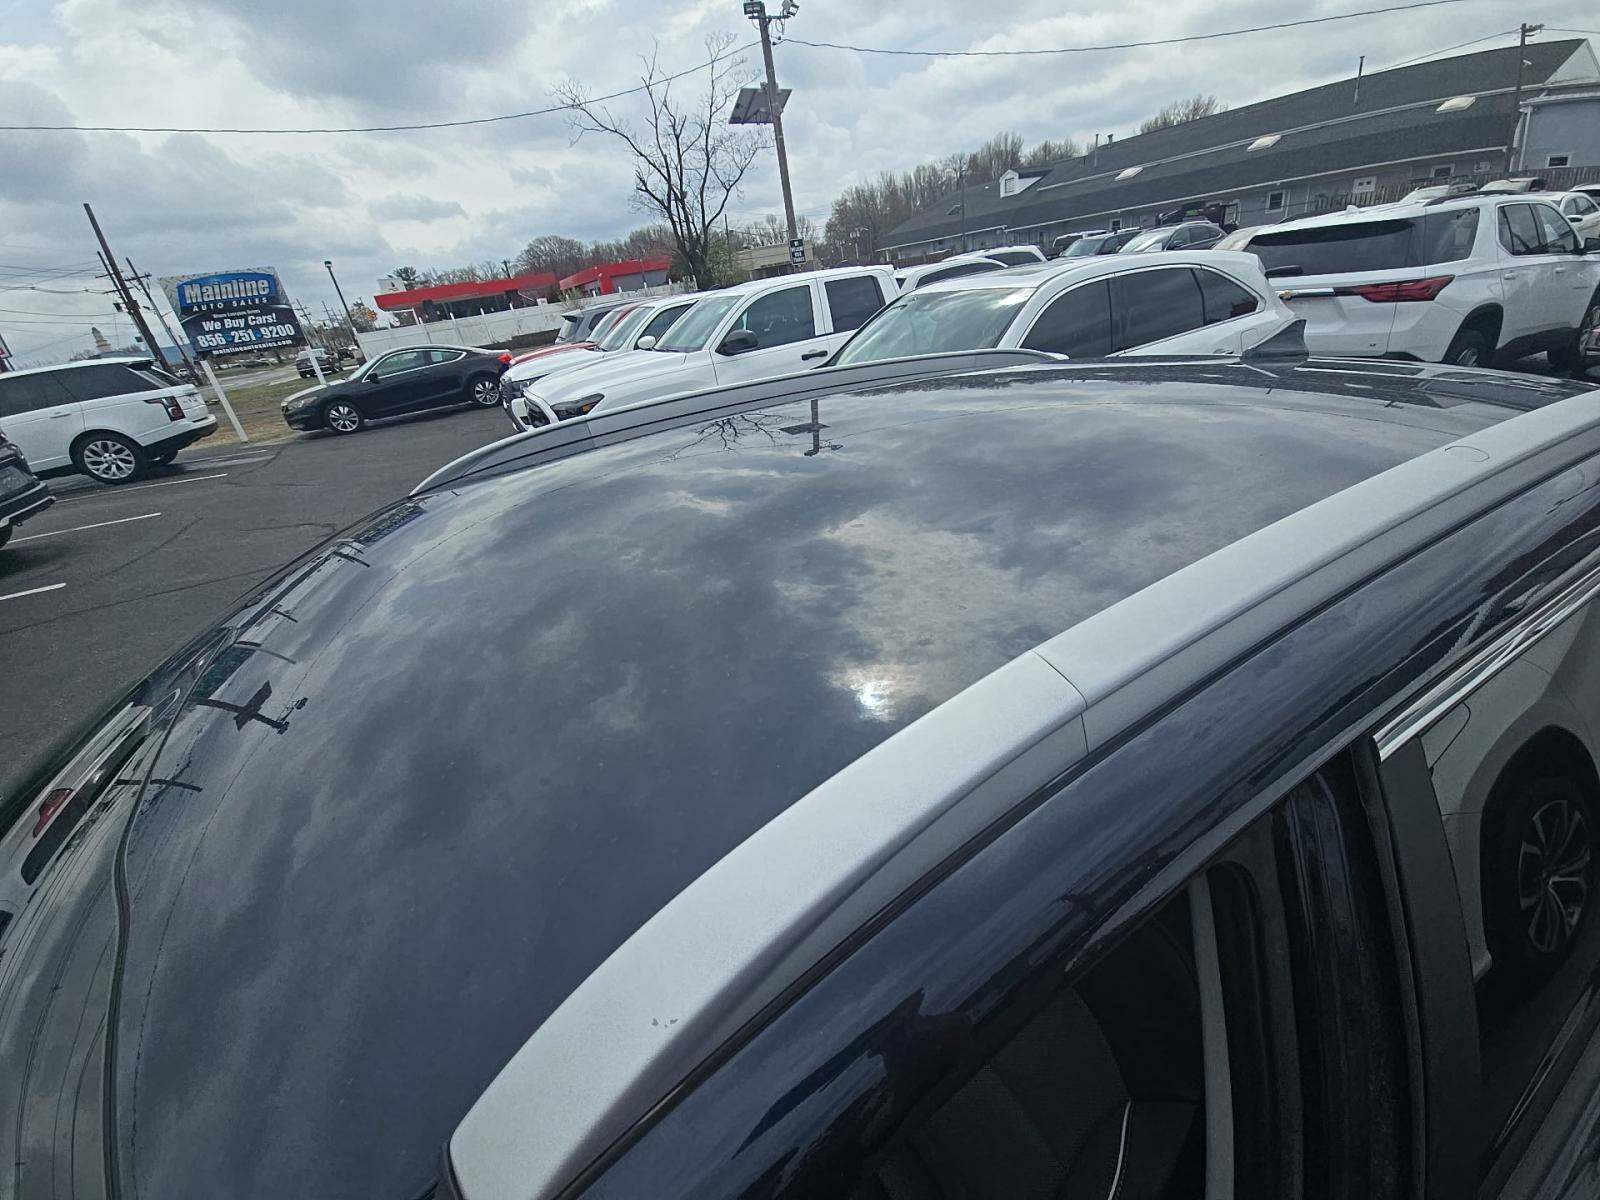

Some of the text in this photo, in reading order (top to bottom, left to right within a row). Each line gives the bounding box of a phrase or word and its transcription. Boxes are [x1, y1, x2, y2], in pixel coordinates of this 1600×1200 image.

[183, 279, 270, 304] Mainline
[192, 297, 268, 312] AUTO SALES
[202, 320, 222, 332] We
[224, 318, 245, 329] Buy
[248, 313, 277, 326] Cars!
[197, 323, 295, 348] 856 251 9200
